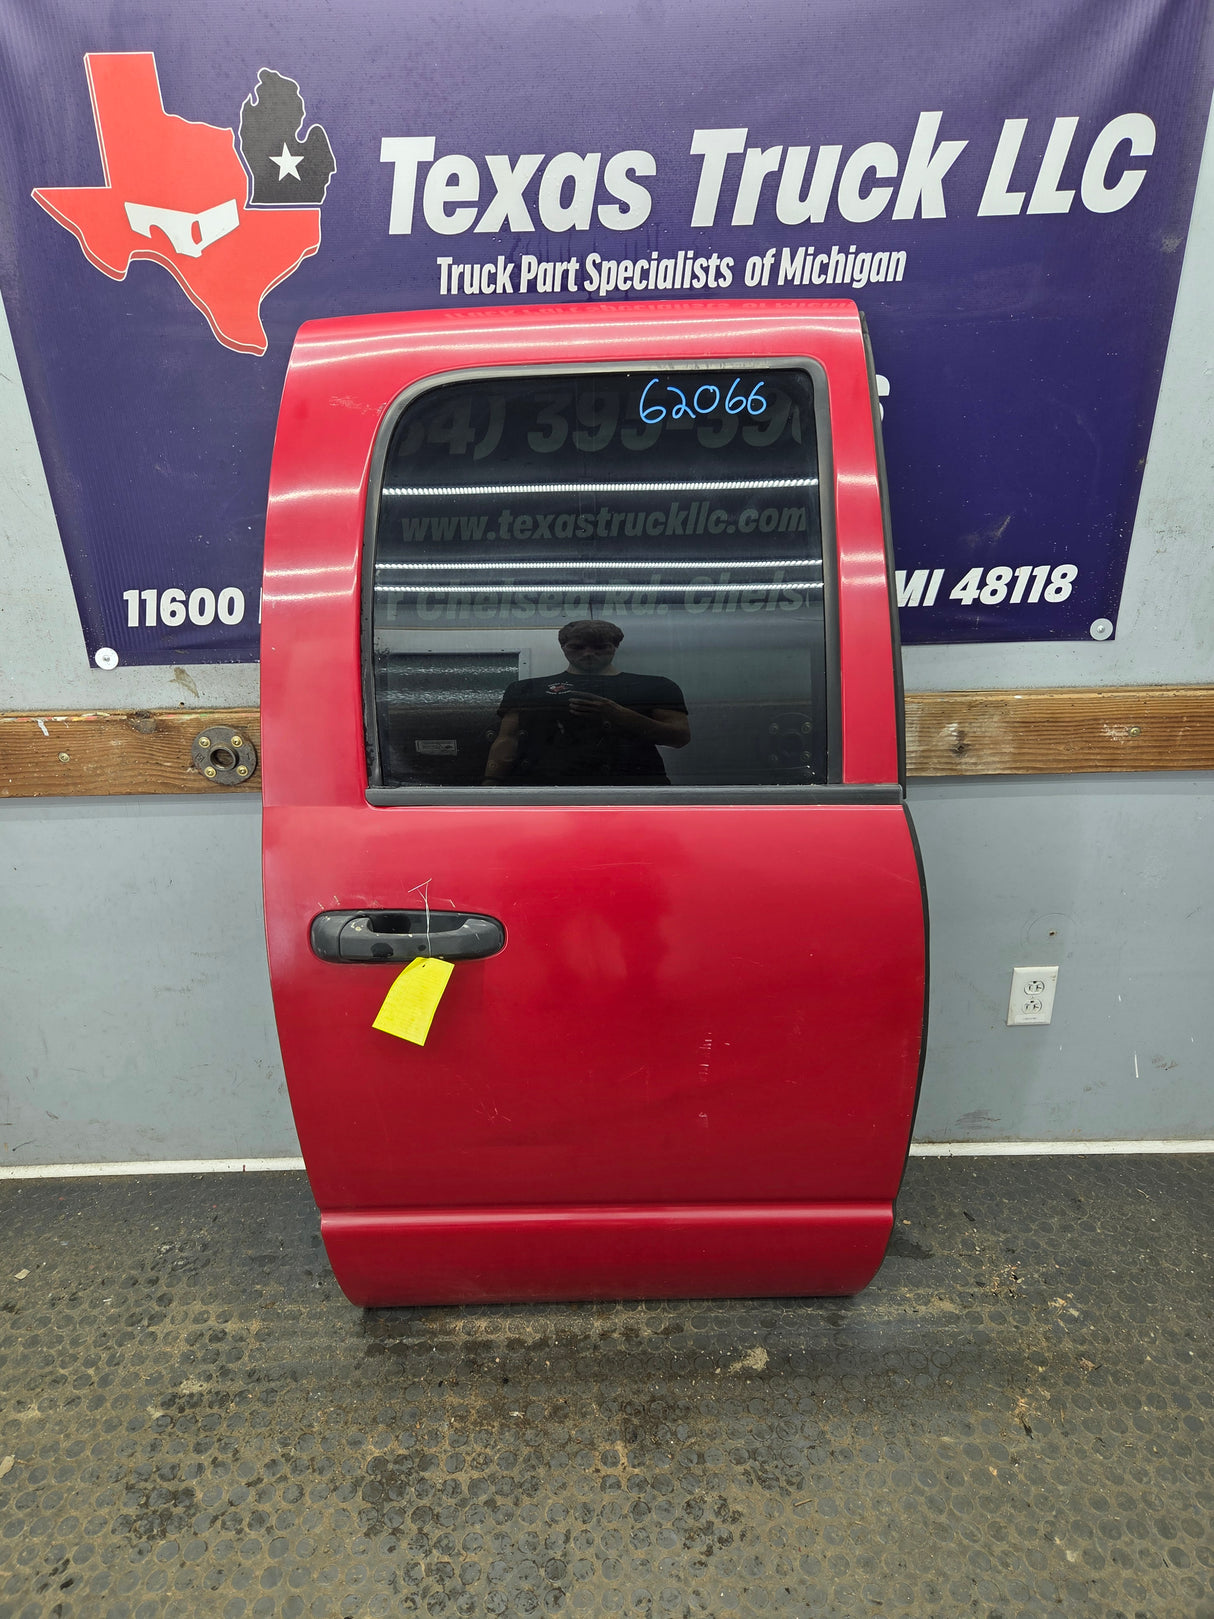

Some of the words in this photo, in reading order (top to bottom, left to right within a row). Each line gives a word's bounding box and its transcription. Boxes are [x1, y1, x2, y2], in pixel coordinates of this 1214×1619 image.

[379, 135, 657, 236] Texas
[689, 110, 970, 228] Truck
[976, 112, 1157, 217] LLC
[436, 255, 515, 295] Truck
[518, 254, 580, 294] Part
[583, 250, 735, 297] Specialists
[744, 247, 777, 287] of
[777, 244, 907, 289] Michigan
[639, 378, 767, 424] 62066
[401, 501, 806, 542] www.texastruckllc.com
[123, 586, 245, 628] 11600
[416, 577, 591, 621] Chelsea
[601, 573, 669, 616] Rd.
[684, 569, 809, 615] Chels
[894, 568, 945, 608] MI
[949, 564, 1079, 605] 48118
